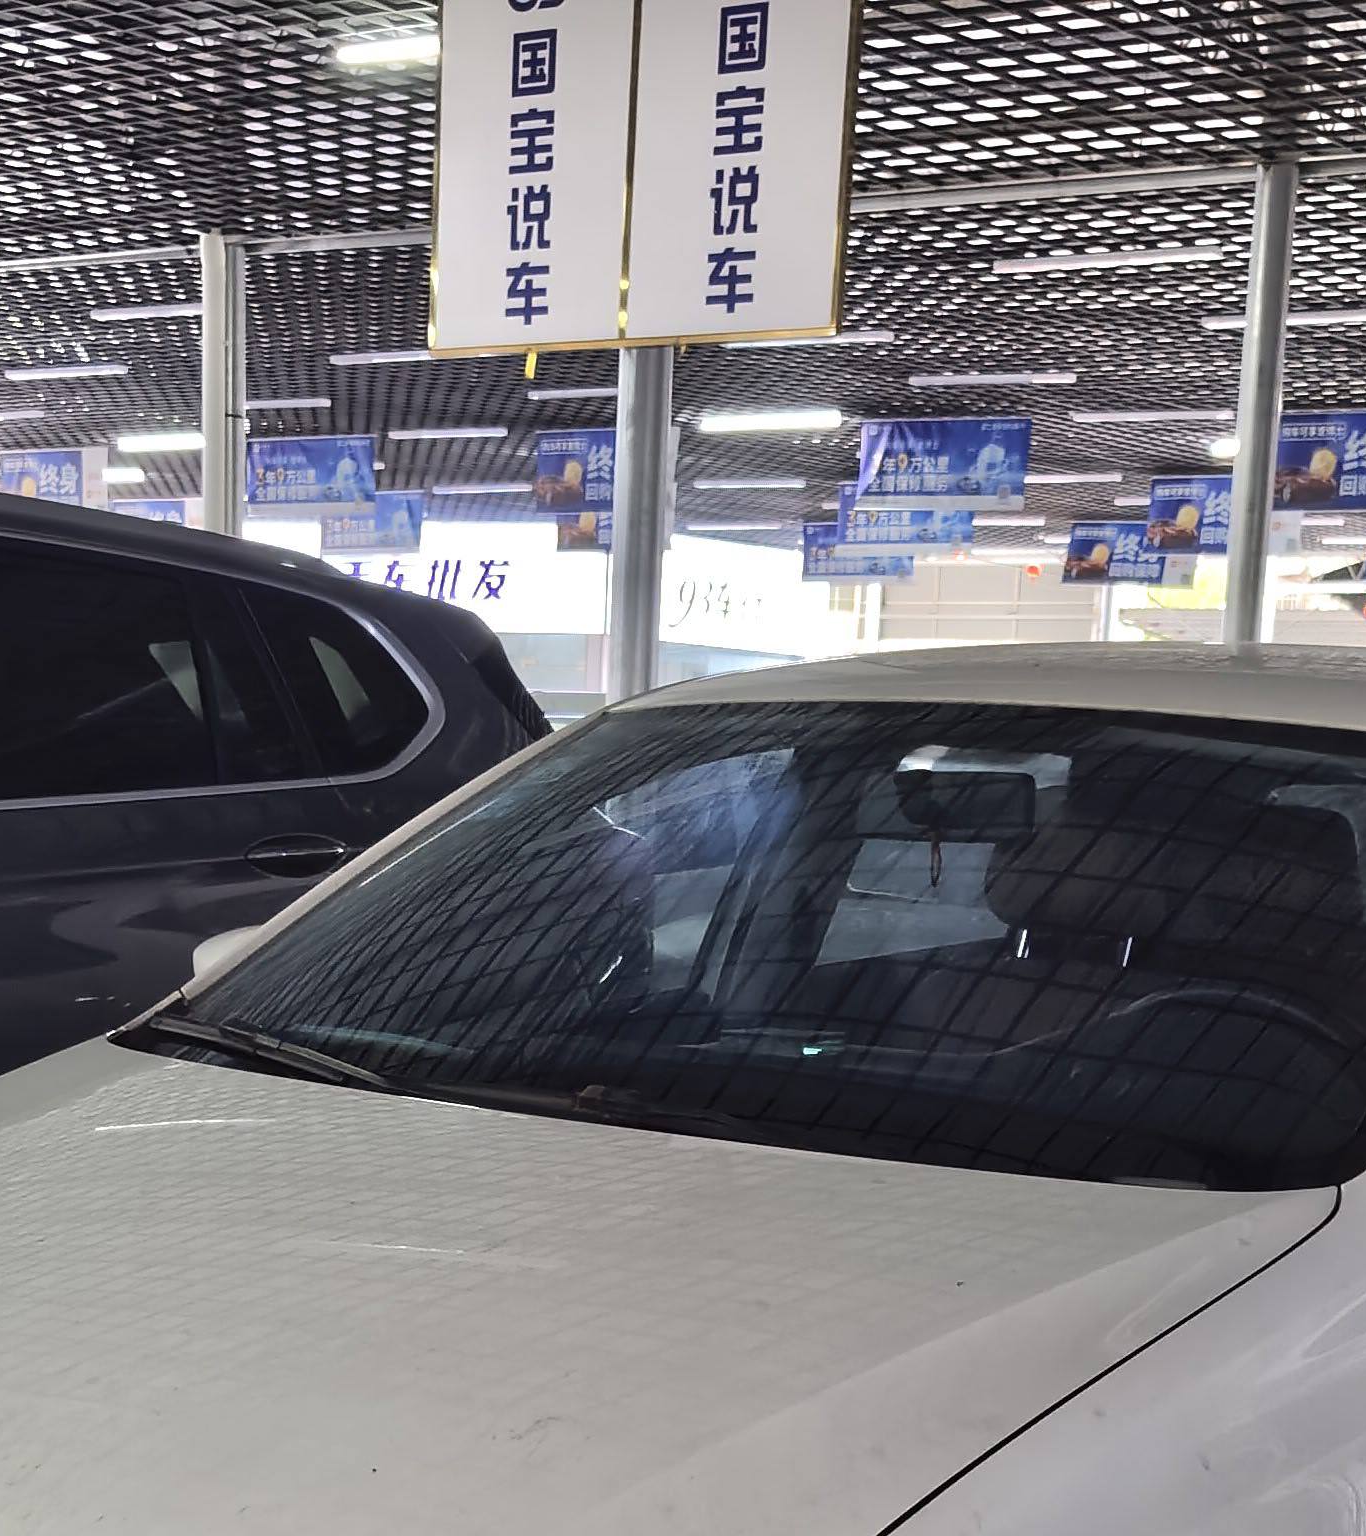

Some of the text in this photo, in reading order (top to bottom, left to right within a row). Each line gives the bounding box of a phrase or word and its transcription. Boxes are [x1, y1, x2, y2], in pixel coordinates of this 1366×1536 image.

[705, 2, 769, 314] 国宝说车
[505, 28, 558, 326] 国宝说车
[39, 463, 79, 496] 终身
[587, 444, 614, 482] 终
[883, 453, 951, 476] 年9万公里
[1202, 490, 1232, 526] 终
